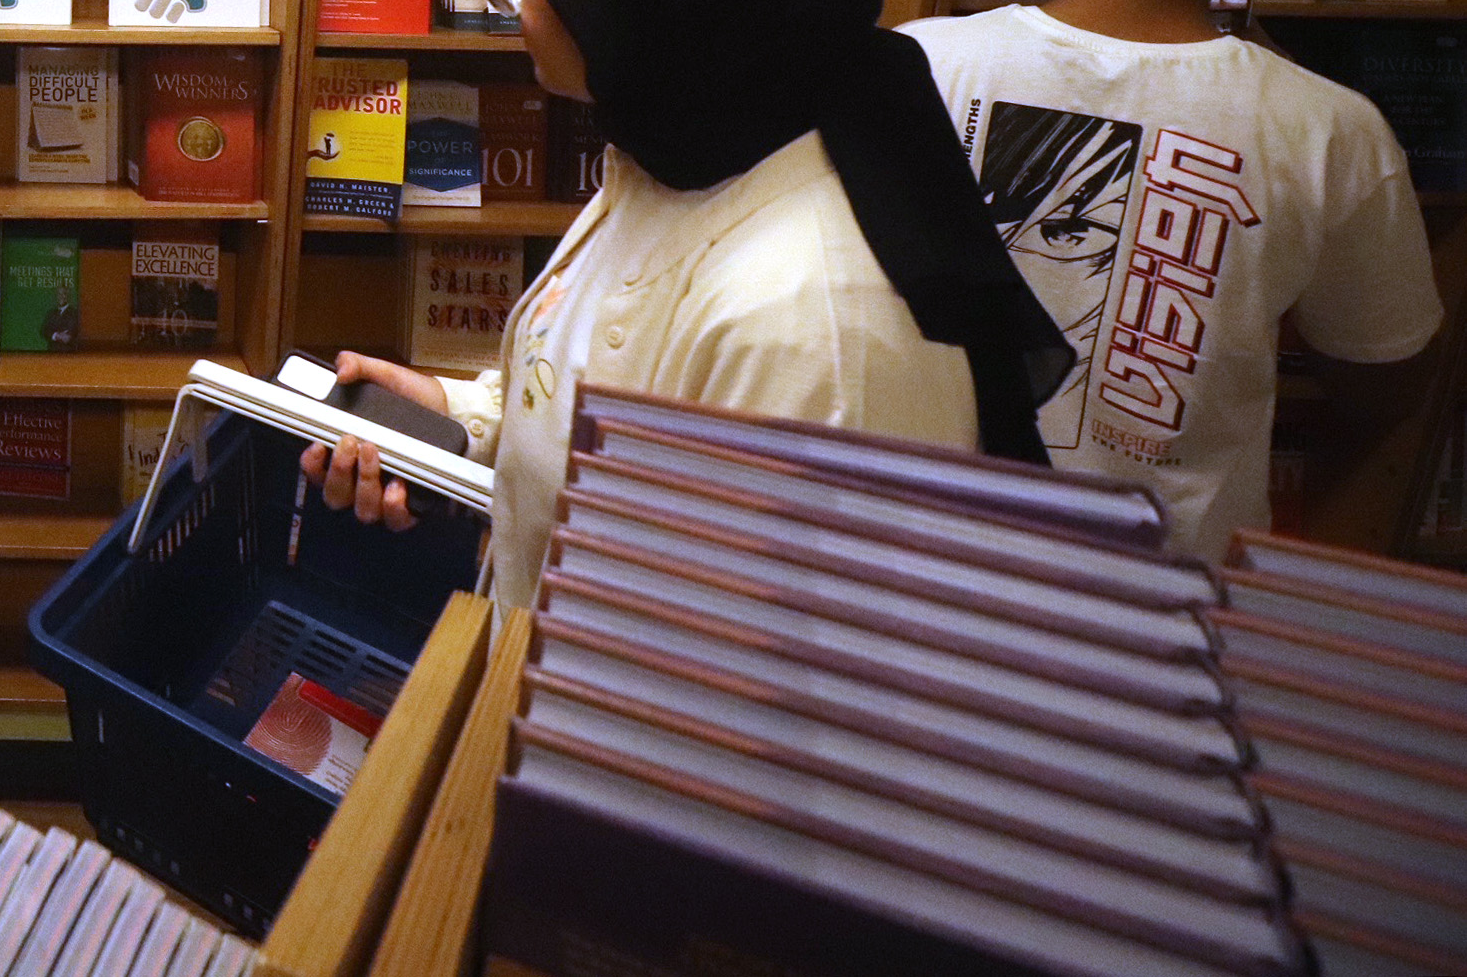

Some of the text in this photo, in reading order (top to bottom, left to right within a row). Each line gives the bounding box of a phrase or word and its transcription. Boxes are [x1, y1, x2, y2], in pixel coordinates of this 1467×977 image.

[29, 76, 99, 88] DIFFICULT
[29, 88, 97, 102] PEOPLE
[313, 95, 402, 115] ADVISOR
[409, 168, 472, 176] SIGNIFICANCE
[136, 245, 214, 261] ELEVATING
[135, 260, 215, 276] EXCELLENCE
[1092, 421, 1171, 456] INSPIRE
[1092, 434, 1182, 468] THE FUTURE
